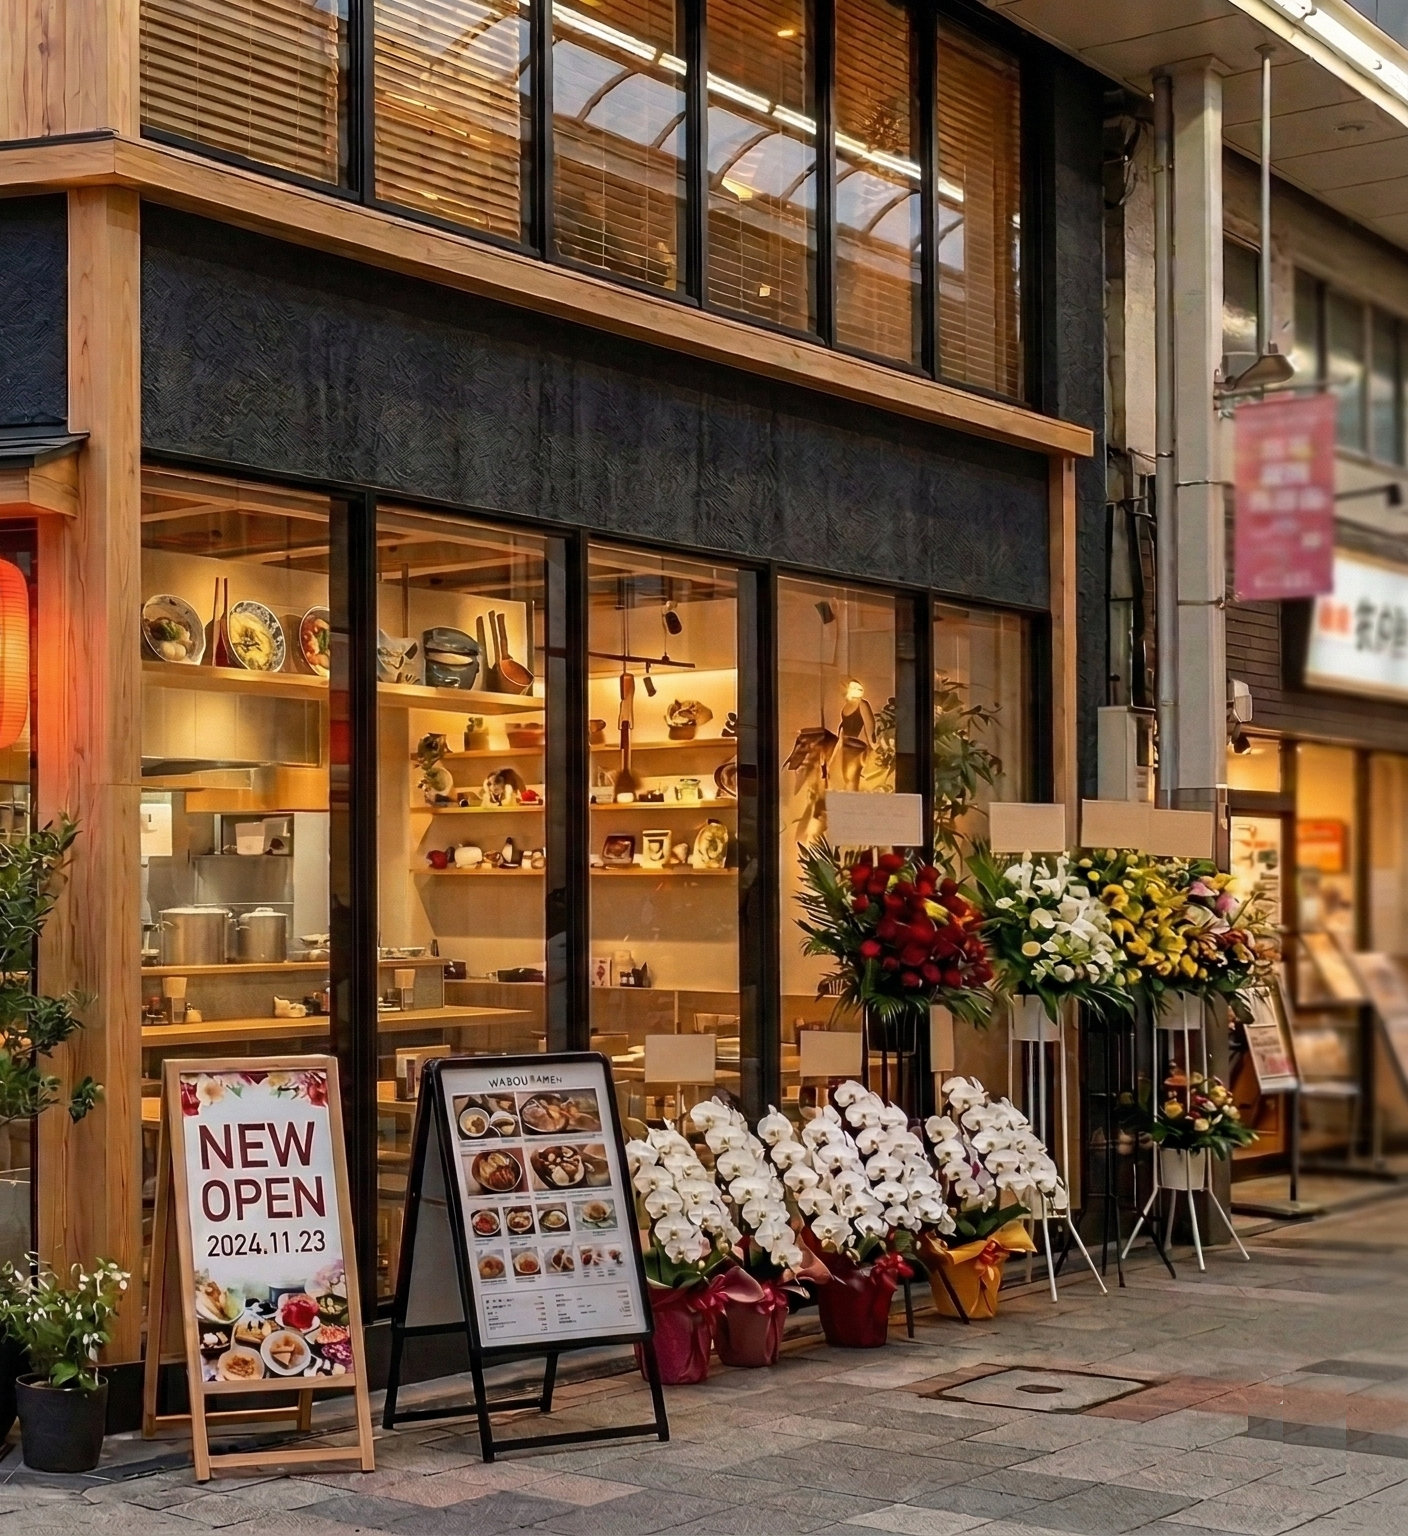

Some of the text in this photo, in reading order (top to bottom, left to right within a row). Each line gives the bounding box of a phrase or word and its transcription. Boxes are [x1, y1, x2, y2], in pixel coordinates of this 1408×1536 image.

[488, 1076, 528, 1088] WABOU
[198, 1121, 315, 1170] NEW
[201, 1175, 326, 1222] OPEN
[207, 1230, 326, 1258] 2024.11.23
